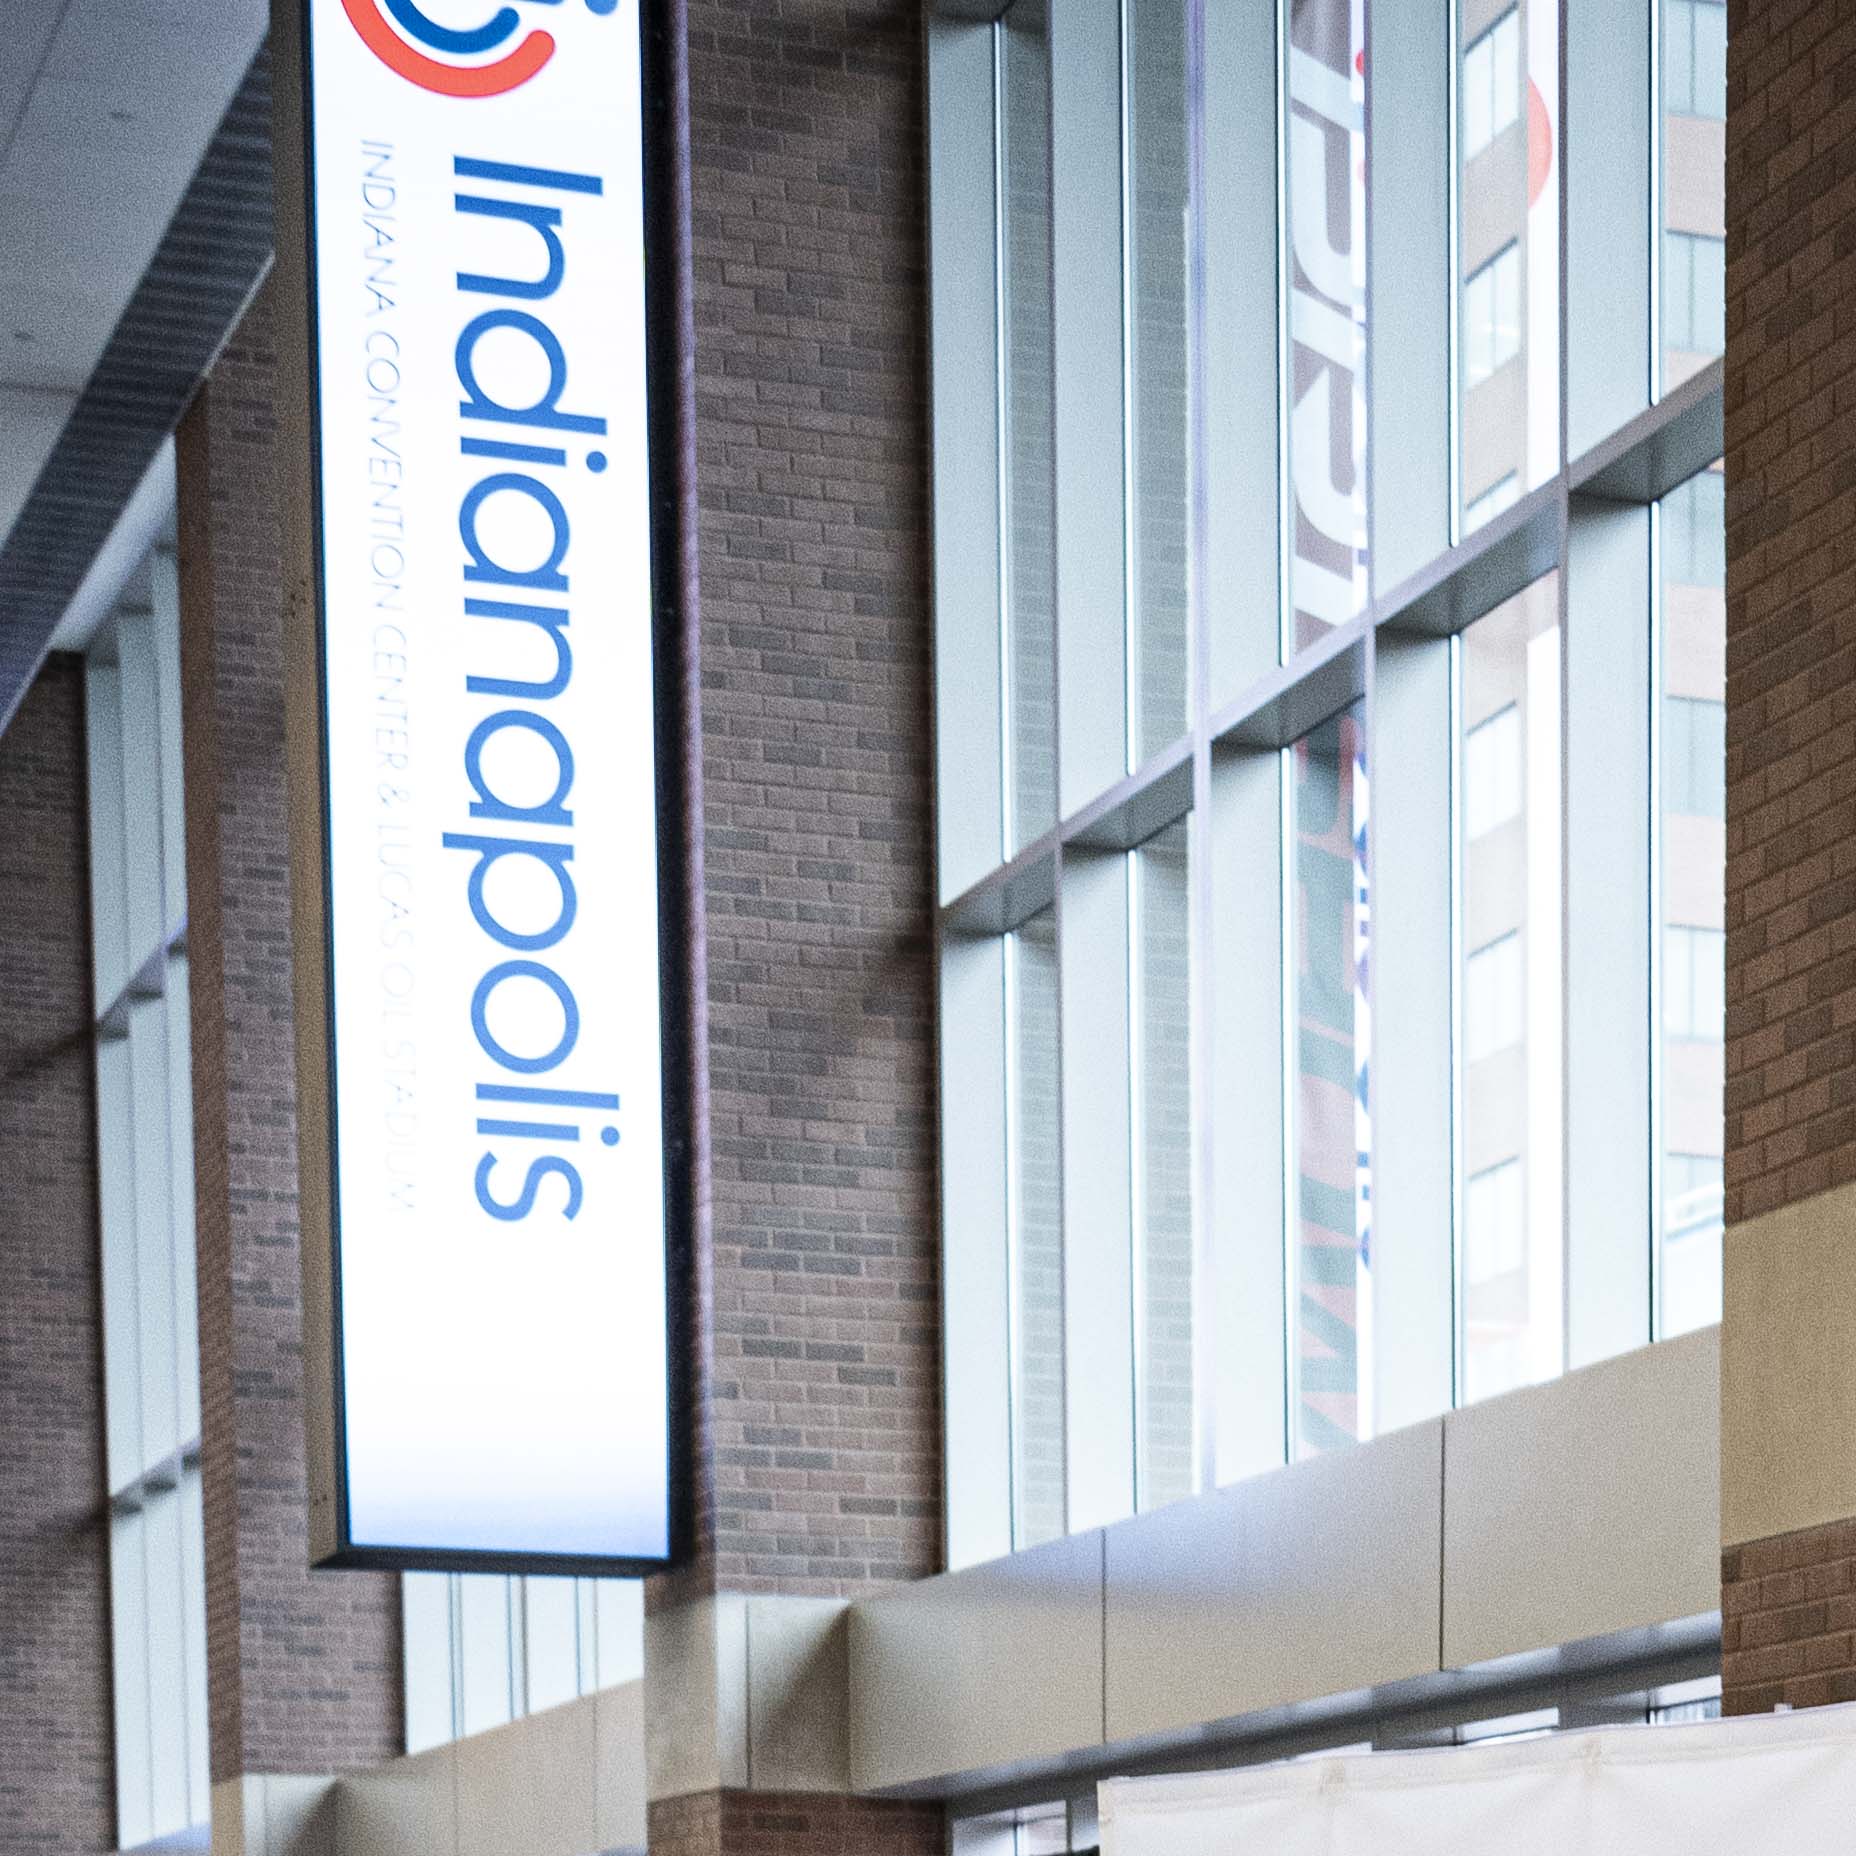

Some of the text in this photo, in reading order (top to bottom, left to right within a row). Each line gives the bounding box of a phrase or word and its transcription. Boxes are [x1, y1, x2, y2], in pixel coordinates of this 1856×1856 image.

[360, 138, 397, 320] INDIANA
[365, 330, 405, 610] CONVENTION
[373, 623, 410, 770] CENTER
[442, 154, 621, 1222] Indianapolis
[379, 782, 411, 808] &
[379, 823, 414, 949] LUCAS
[381, 962, 416, 1026] OIL
